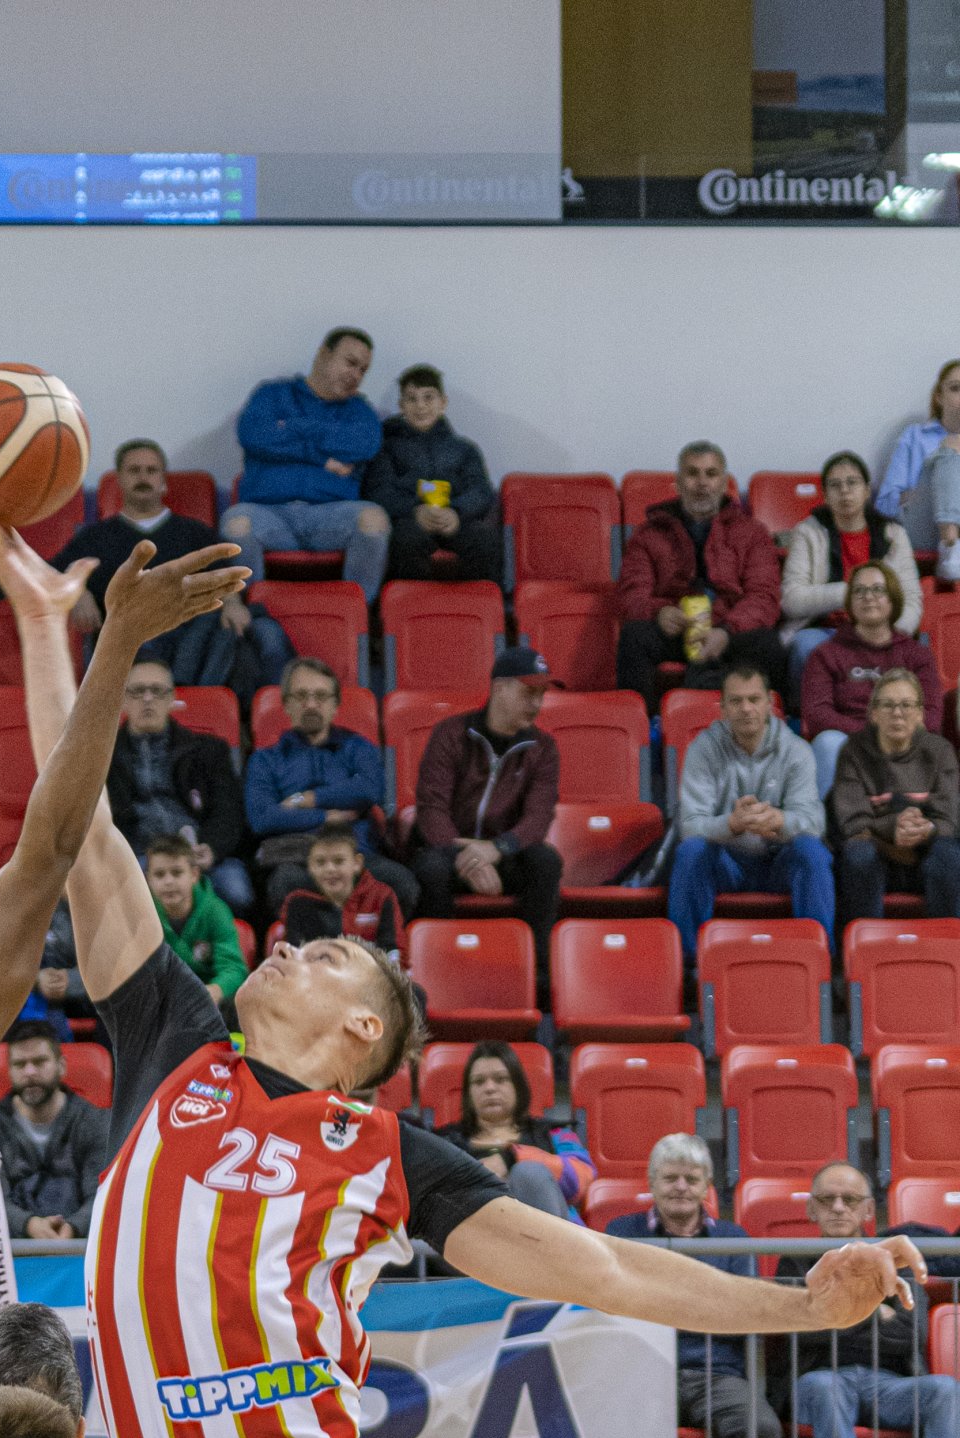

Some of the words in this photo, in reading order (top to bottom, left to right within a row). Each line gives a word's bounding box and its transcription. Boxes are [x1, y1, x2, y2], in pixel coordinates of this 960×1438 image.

[351, 168, 553, 214] Continental
[698, 168, 897, 215] Continental
[203, 1127, 301, 1196] 25
